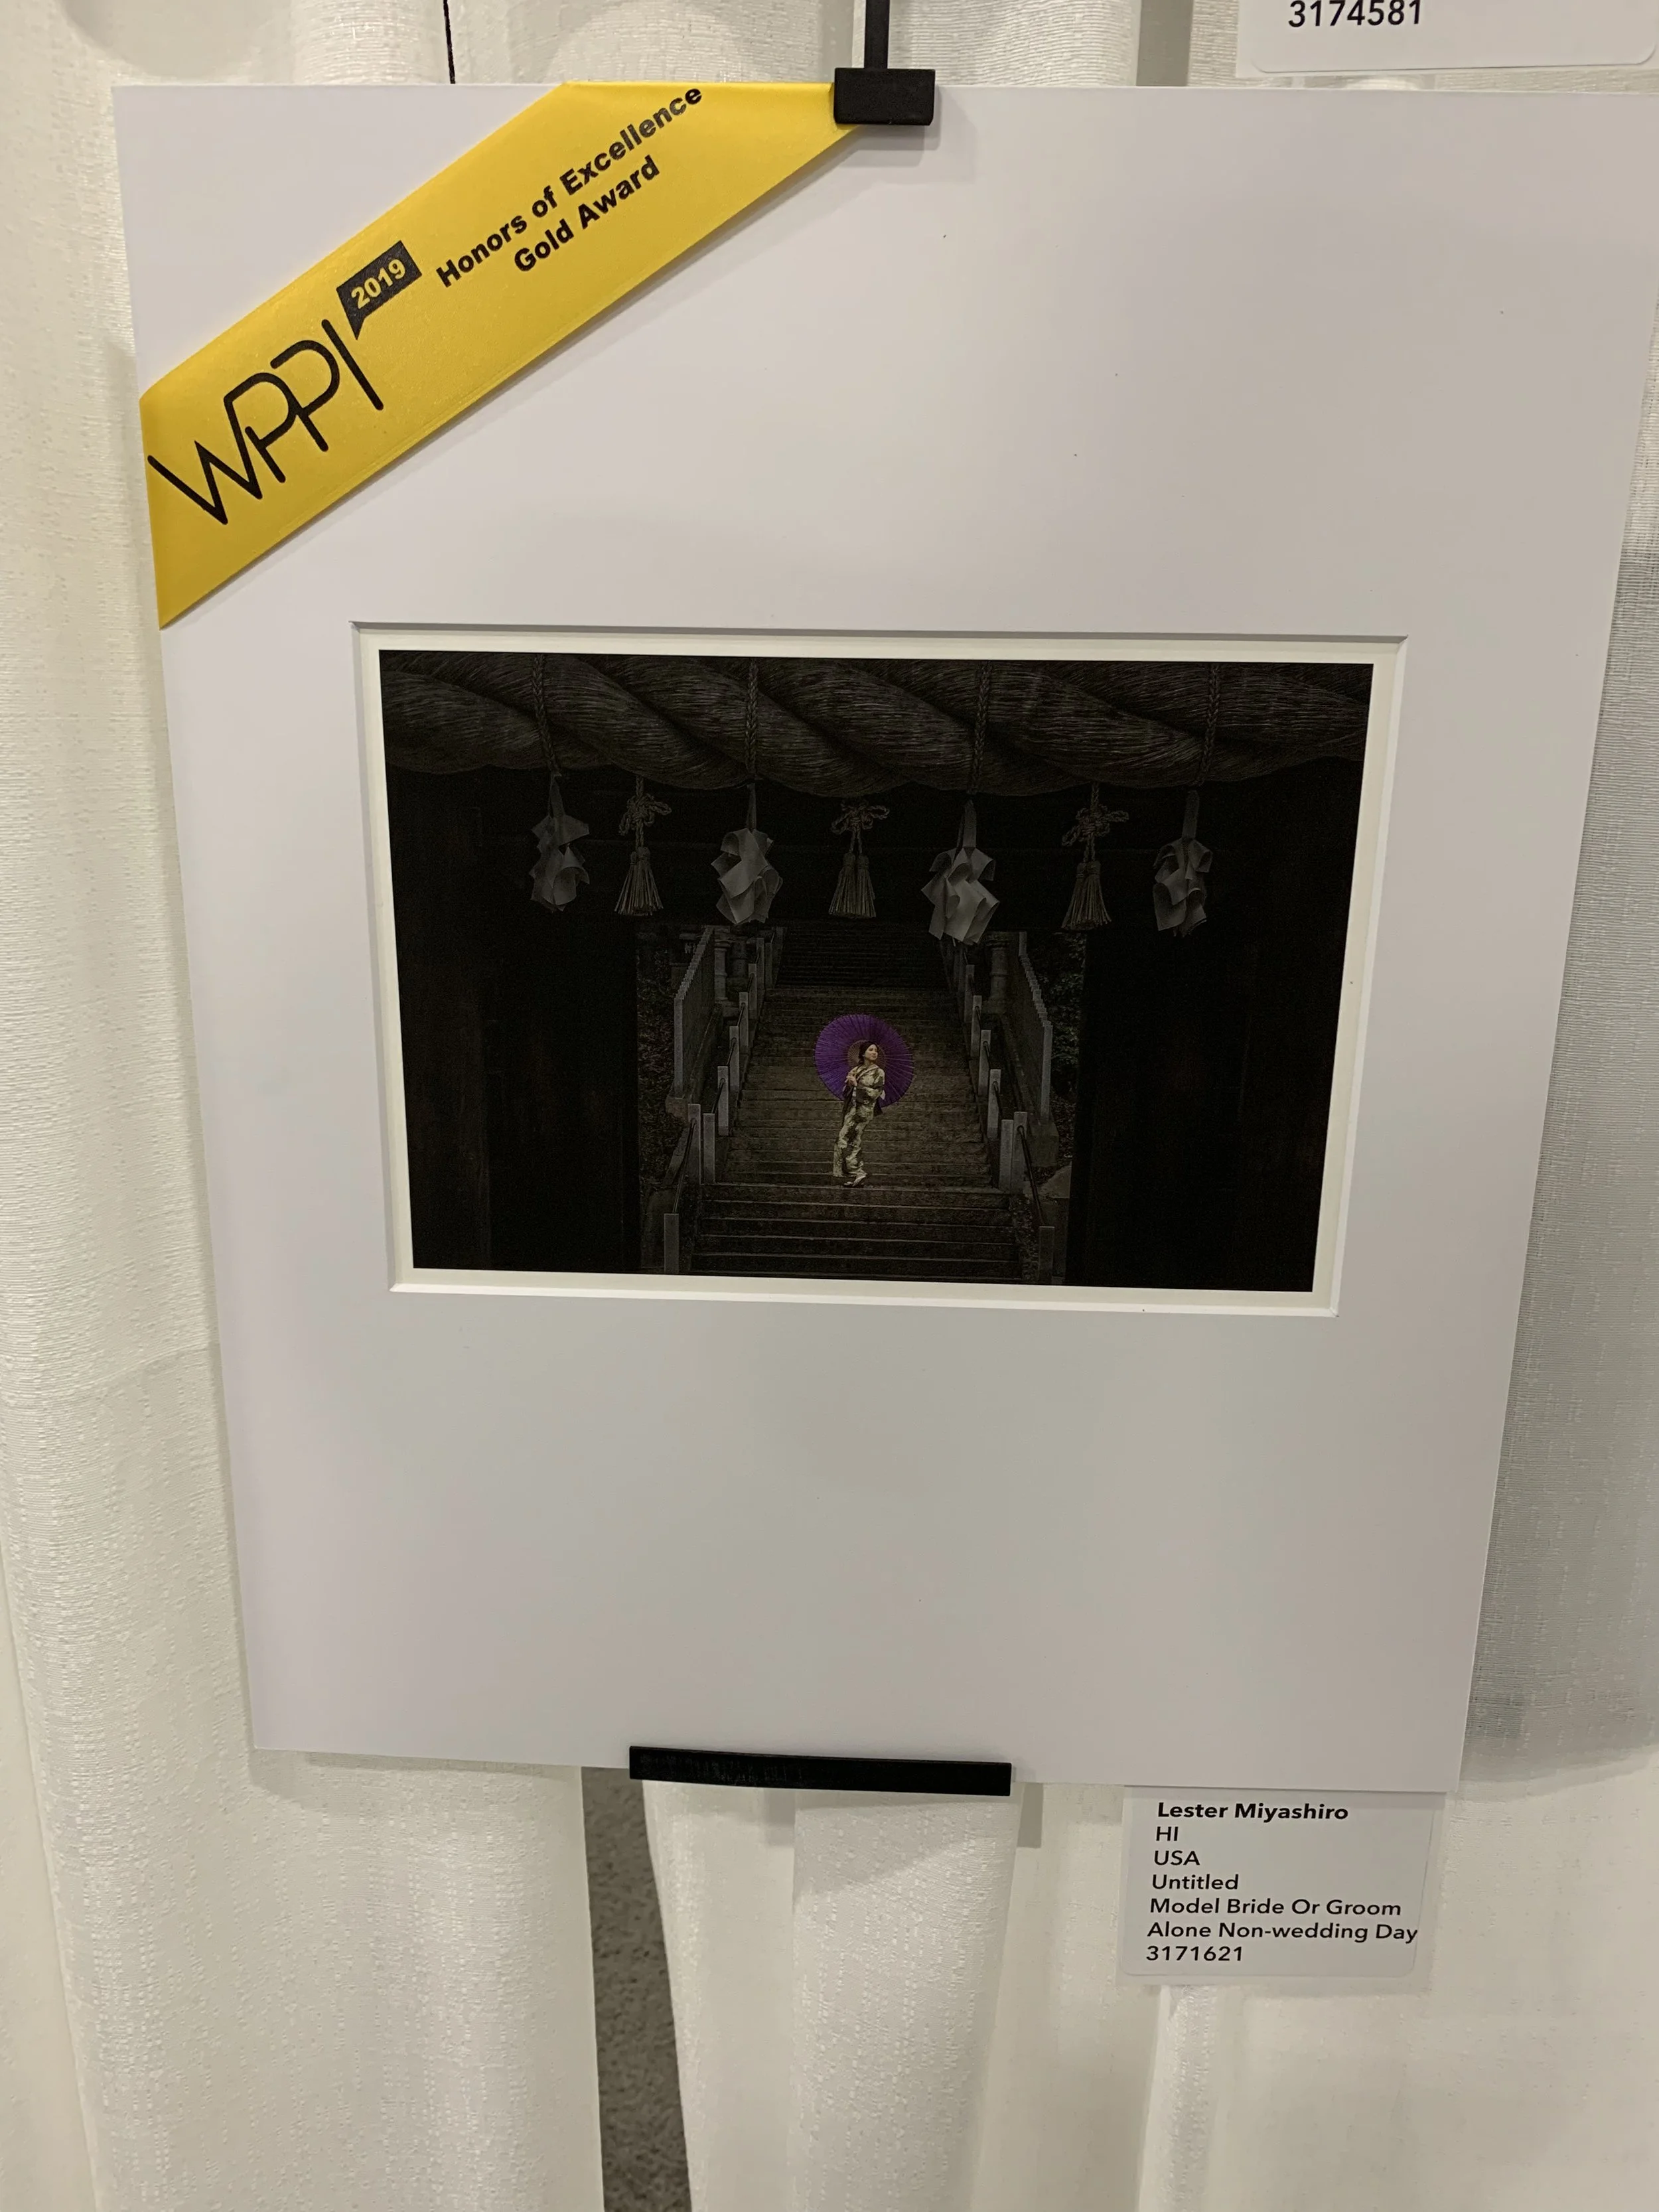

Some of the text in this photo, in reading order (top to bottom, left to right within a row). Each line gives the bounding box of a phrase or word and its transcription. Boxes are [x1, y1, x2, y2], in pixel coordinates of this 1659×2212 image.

[1288, 0, 1421, 27] 3174581
[435, 88, 702, 288] Honors of Excellence
[514, 154, 660, 271] Gold Award
[350, 258, 406, 310] 2019
[147, 319, 384, 526] WPPI
[1158, 1802, 1348, 1823] Lester Miyashiro
[1155, 1826, 1179, 1842] HI
[1154, 1850, 1200, 1866] USA
[1152, 1874, 1239, 1890] Untitled
[1150, 1897, 1401, 1916] Model Bride Or Groom
[1147, 1921, 1418, 1945] Alone Non-wedding Day
[1146, 1945, 1242, 1962] 3171621
